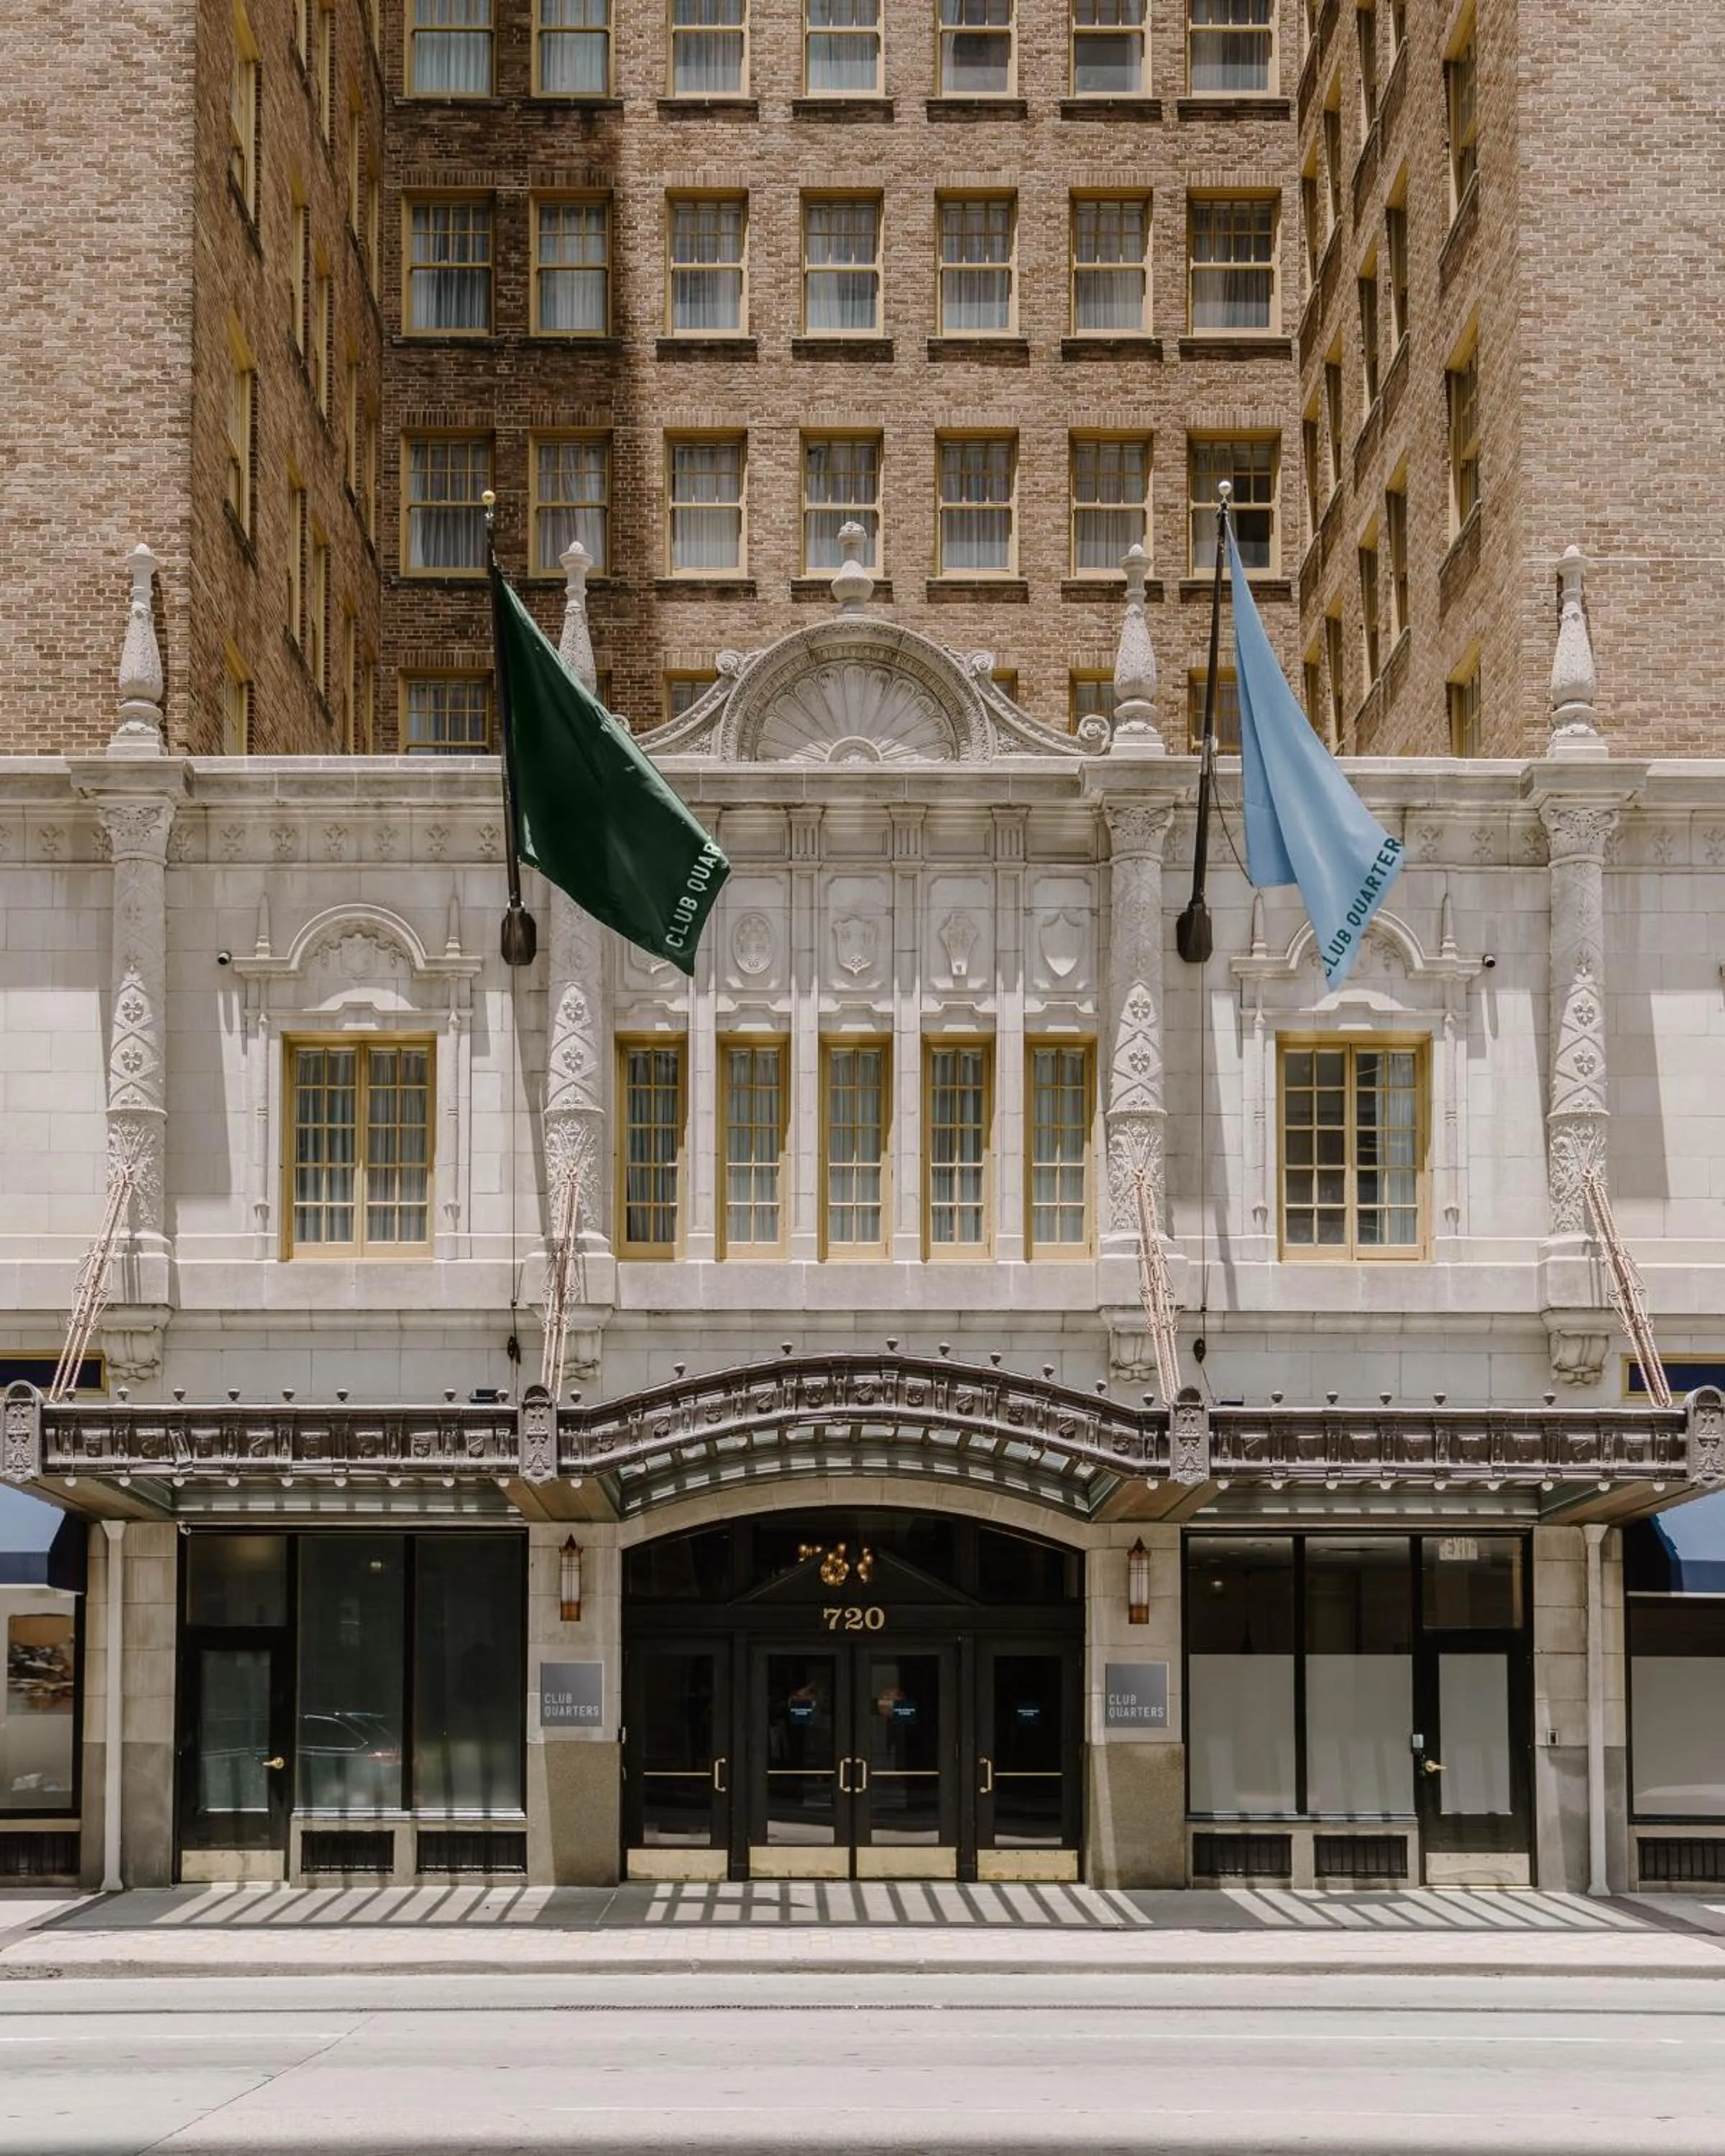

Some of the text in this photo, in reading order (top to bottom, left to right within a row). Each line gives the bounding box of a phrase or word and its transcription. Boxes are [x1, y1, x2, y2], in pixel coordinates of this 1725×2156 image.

[666, 896, 698, 948] CLUB
[823, 1607, 885, 1630] 720
[544, 1692, 572, 1704] CLUB
[1109, 1694, 1136, 1705] CLUB
[544, 1705, 599, 1717] QUARTERS
[1109, 1707, 1164, 1718] QUARTERS
